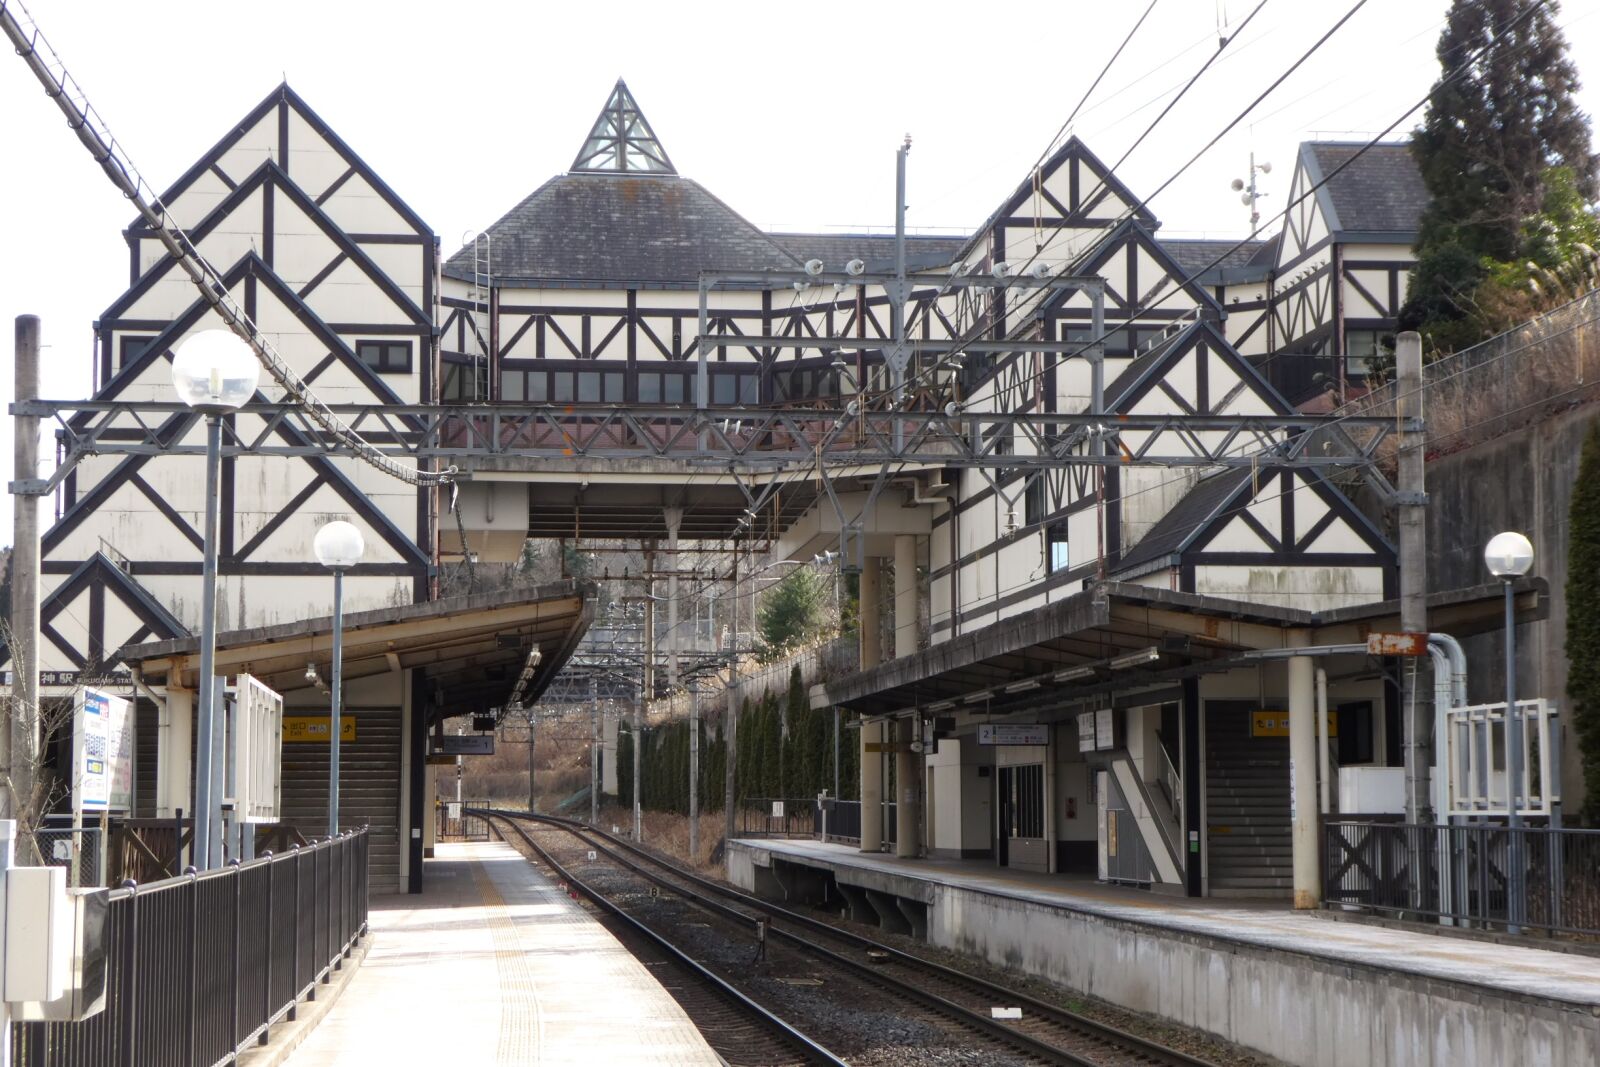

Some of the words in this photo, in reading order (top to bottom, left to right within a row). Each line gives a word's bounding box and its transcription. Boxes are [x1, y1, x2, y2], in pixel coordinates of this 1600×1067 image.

[41, 673, 73, 684] 神駅
[290, 722, 306, 730] 出口
[983, 730, 989, 738] 2
[651, 887, 658, 897] B
